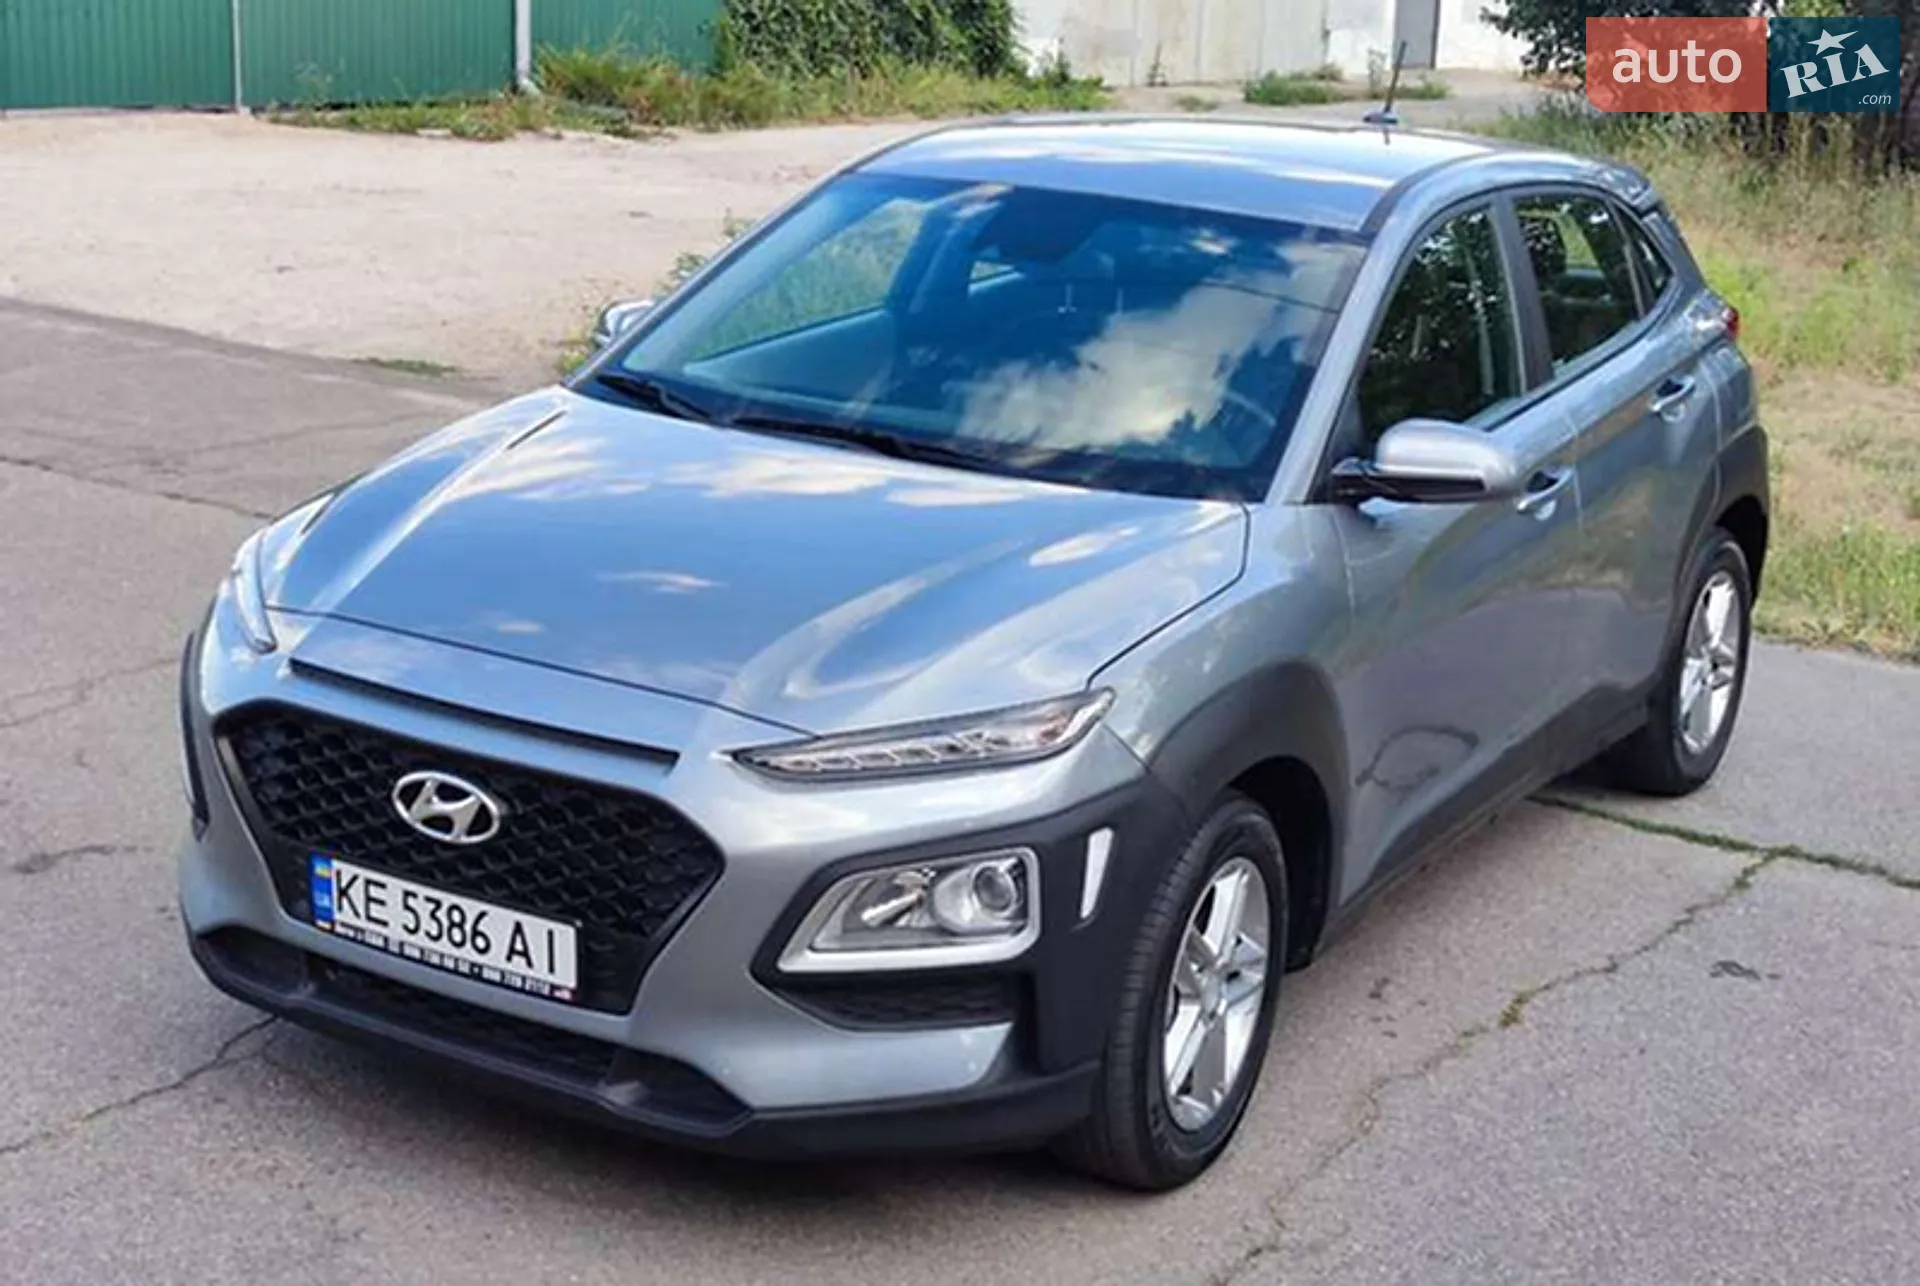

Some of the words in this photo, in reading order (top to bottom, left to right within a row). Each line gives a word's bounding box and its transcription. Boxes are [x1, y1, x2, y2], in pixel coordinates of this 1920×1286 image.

[335, 869, 390, 928] KE
[402, 890, 492, 955] 5386
[506, 921, 555, 975] AI
